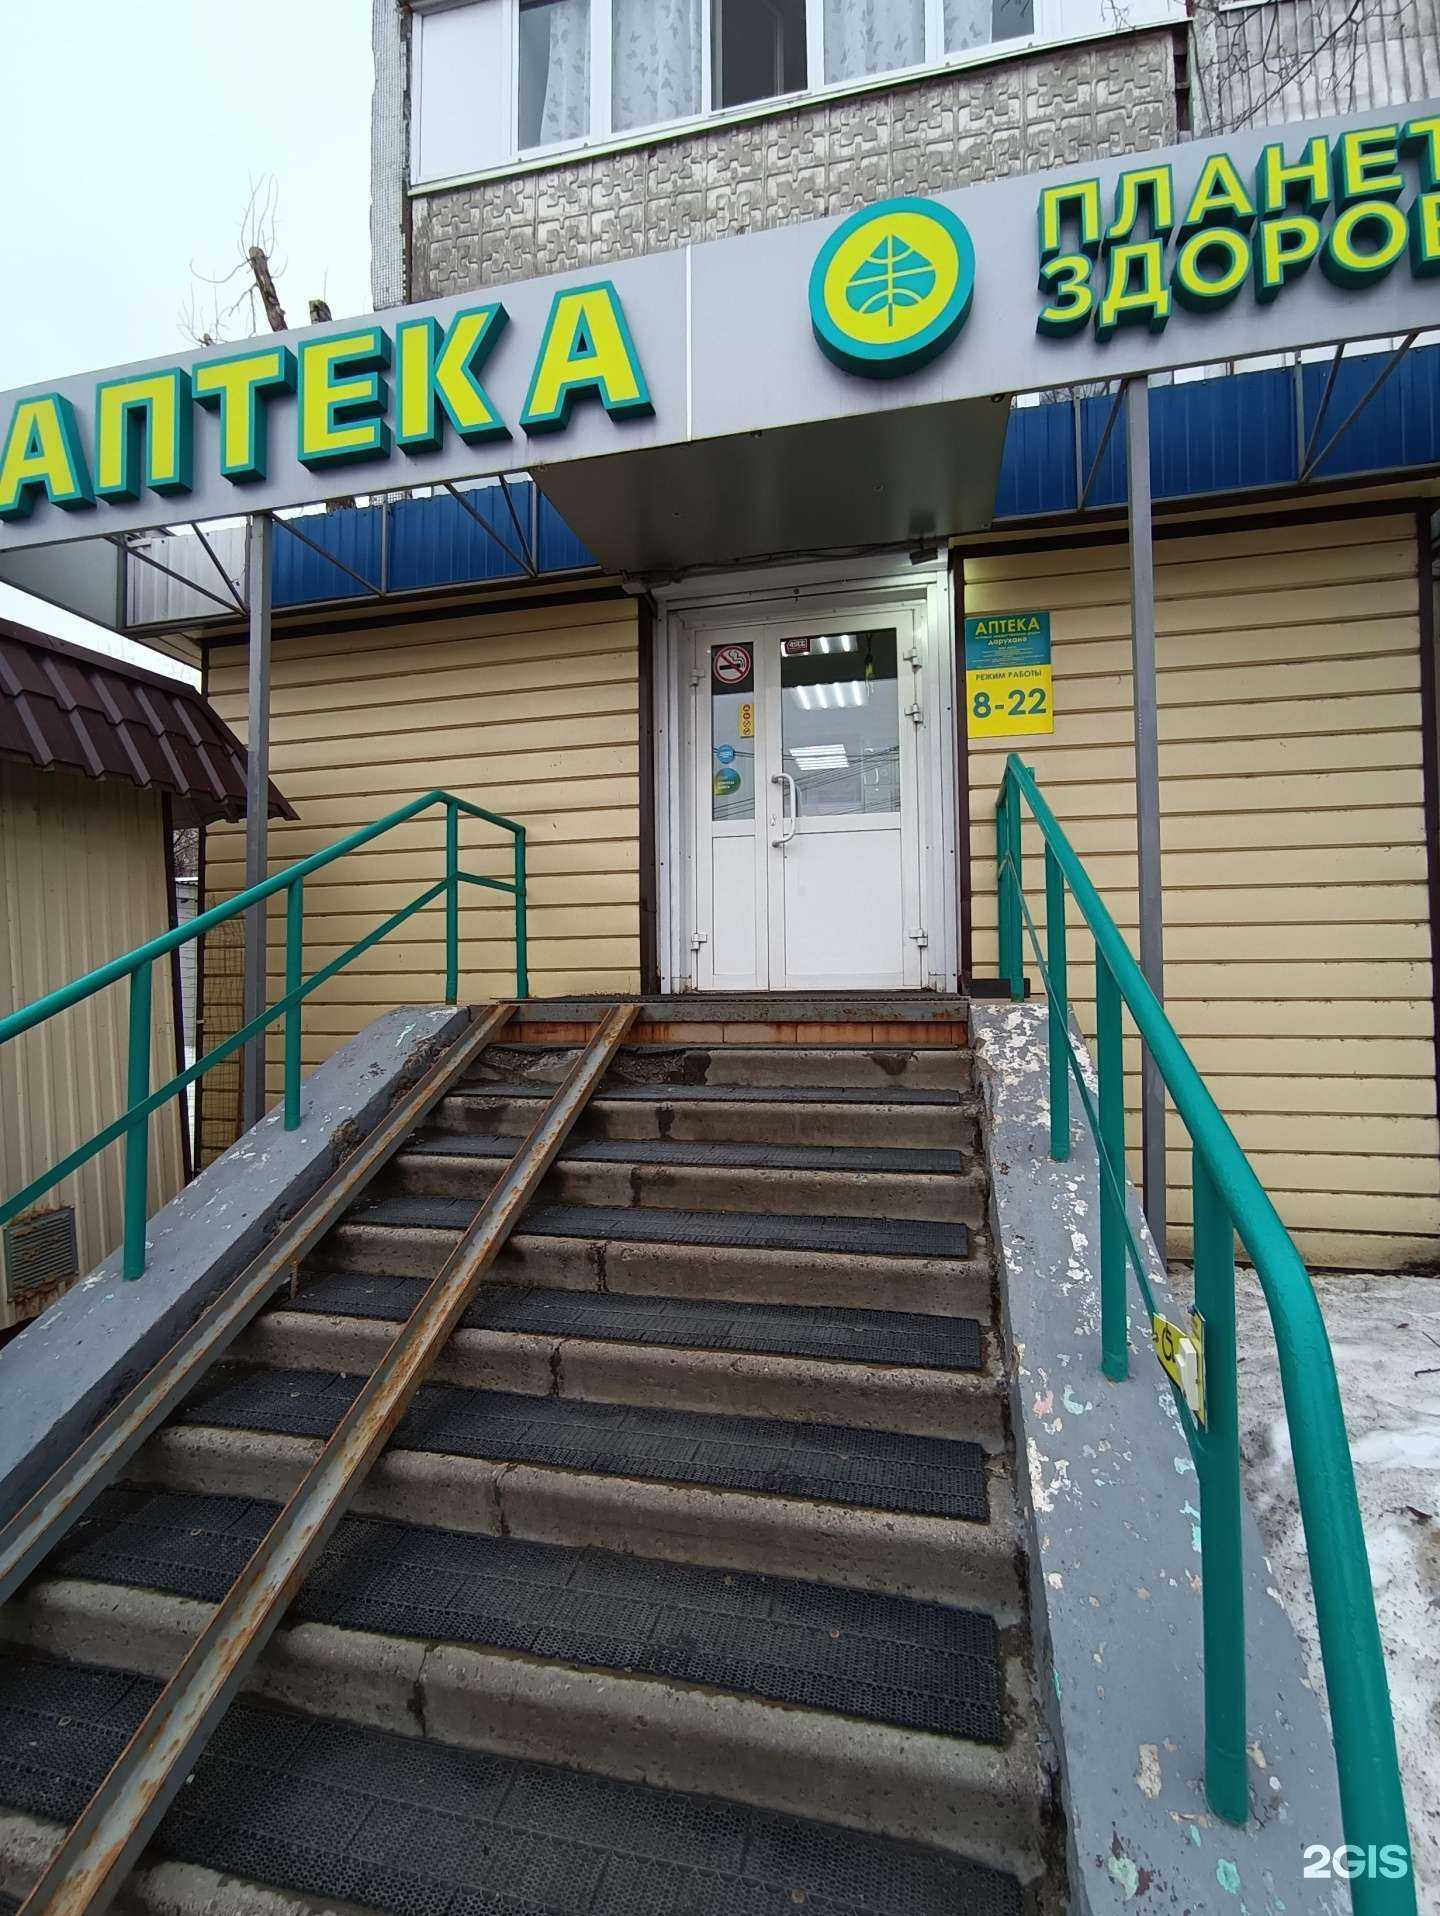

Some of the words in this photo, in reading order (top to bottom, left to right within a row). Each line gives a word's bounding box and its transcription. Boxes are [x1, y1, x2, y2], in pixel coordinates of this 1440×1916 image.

[0, 281, 655, 521] АПТЕКА
[975, 617, 1040, 635] АПТЕКА
[976, 672, 1005, 680] РЕЖИМ
[1008, 670, 1042, 679] РАБОТЫ
[973, 688, 1046, 718] 8-22
